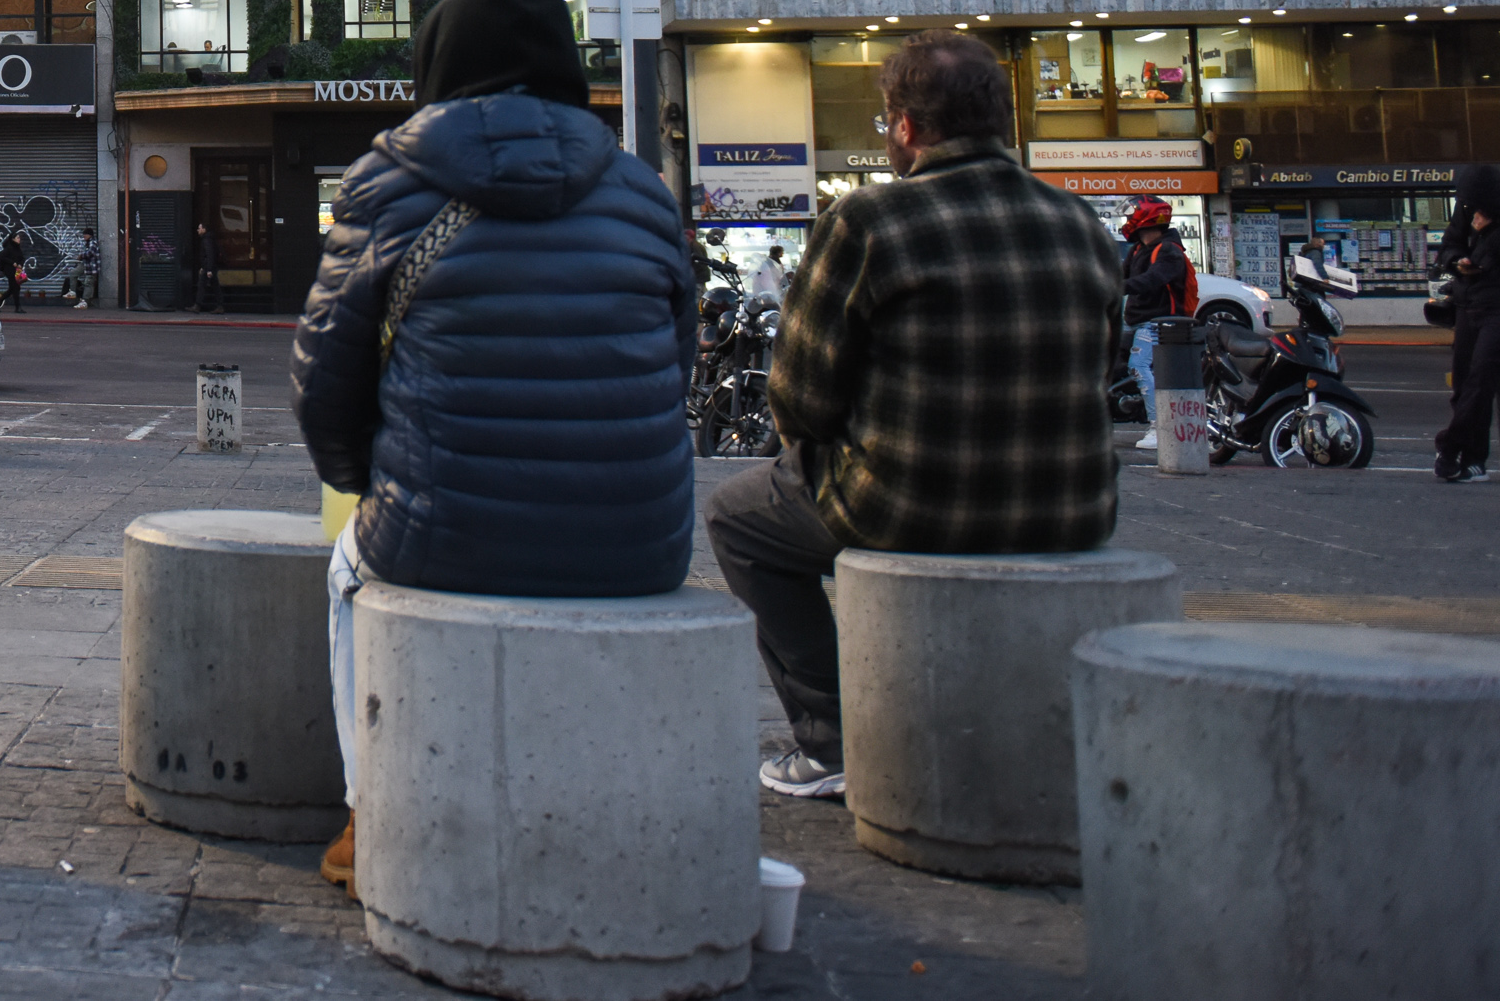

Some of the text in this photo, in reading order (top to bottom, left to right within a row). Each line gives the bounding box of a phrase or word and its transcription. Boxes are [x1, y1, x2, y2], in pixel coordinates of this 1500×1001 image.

[713, 150, 761, 162] TALIZ
[1034, 151, 1075, 159] RELOJES
[1082, 151, 1119, 159] MALLAS
[1126, 150, 1152, 158] PILAS
[1160, 150, 1198, 158] SERVICE
[1269, 172, 1313, 182] Abitab
[1336, 168, 1454, 183] Cambio El Trébol
[1064, 176, 1182, 190] la hora exacta
[1248, 261, 1260, 272] 720
[207, 408, 233, 426] UPM
[1174, 422, 1207, 443] UPM
